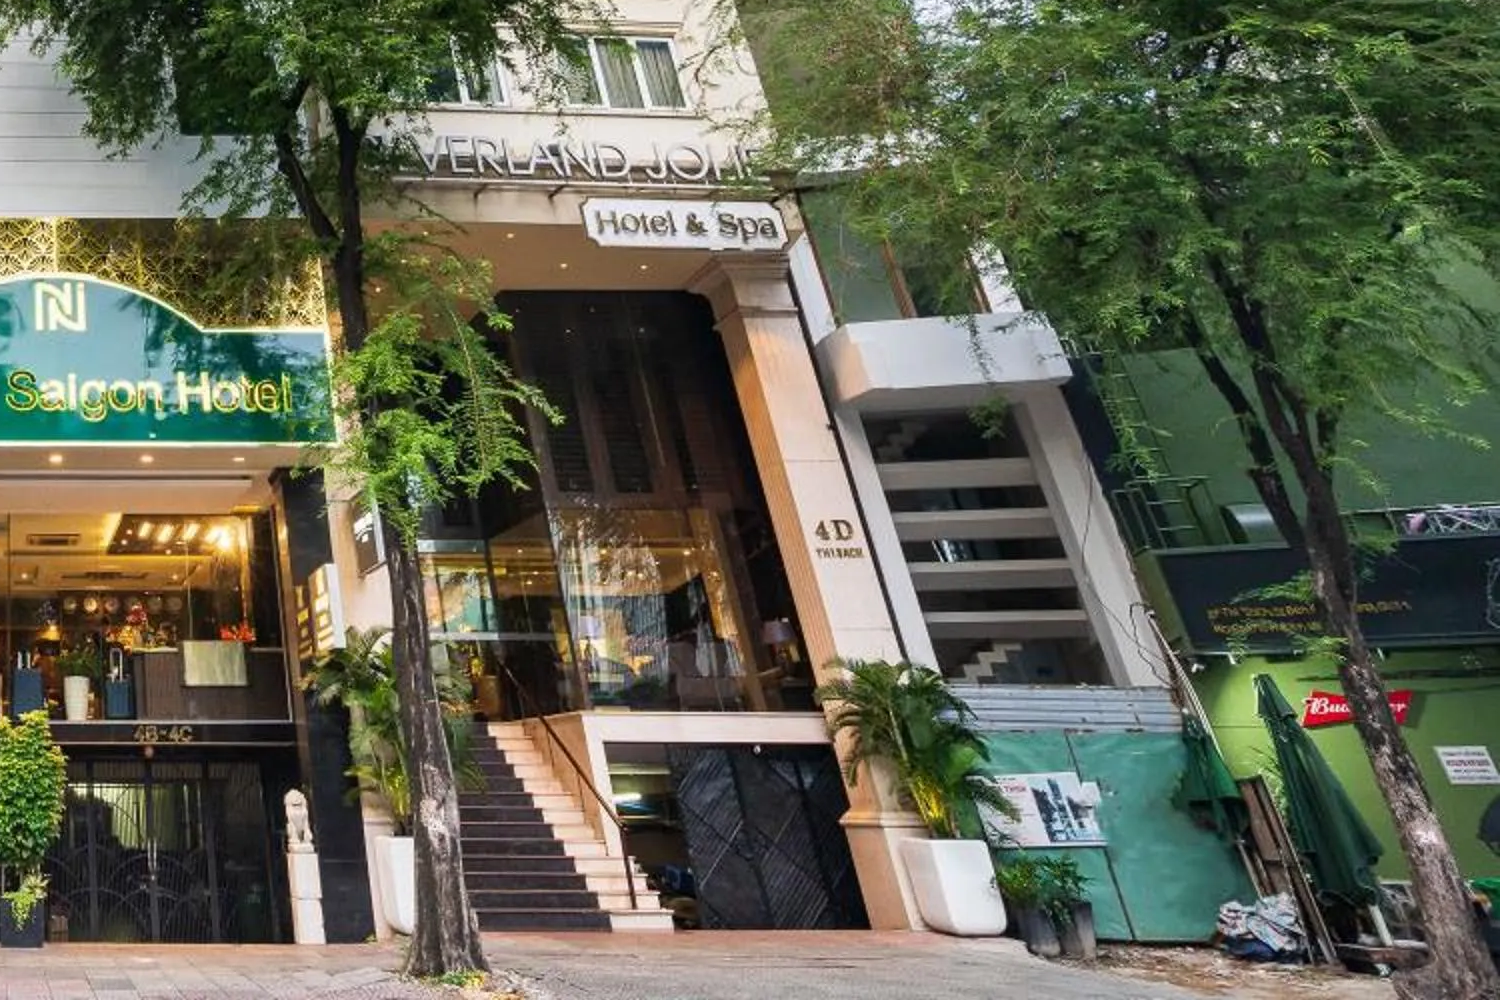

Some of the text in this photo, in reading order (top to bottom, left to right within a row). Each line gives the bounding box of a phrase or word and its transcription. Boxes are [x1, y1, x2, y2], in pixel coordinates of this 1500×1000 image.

[380, 132, 632, 179] VERLAND
[594, 209, 779, 244] Hotel & Spa
[5, 366, 164, 422] Saigon
[176, 370, 294, 415] Hotel
[814, 519, 854, 541] 4D
